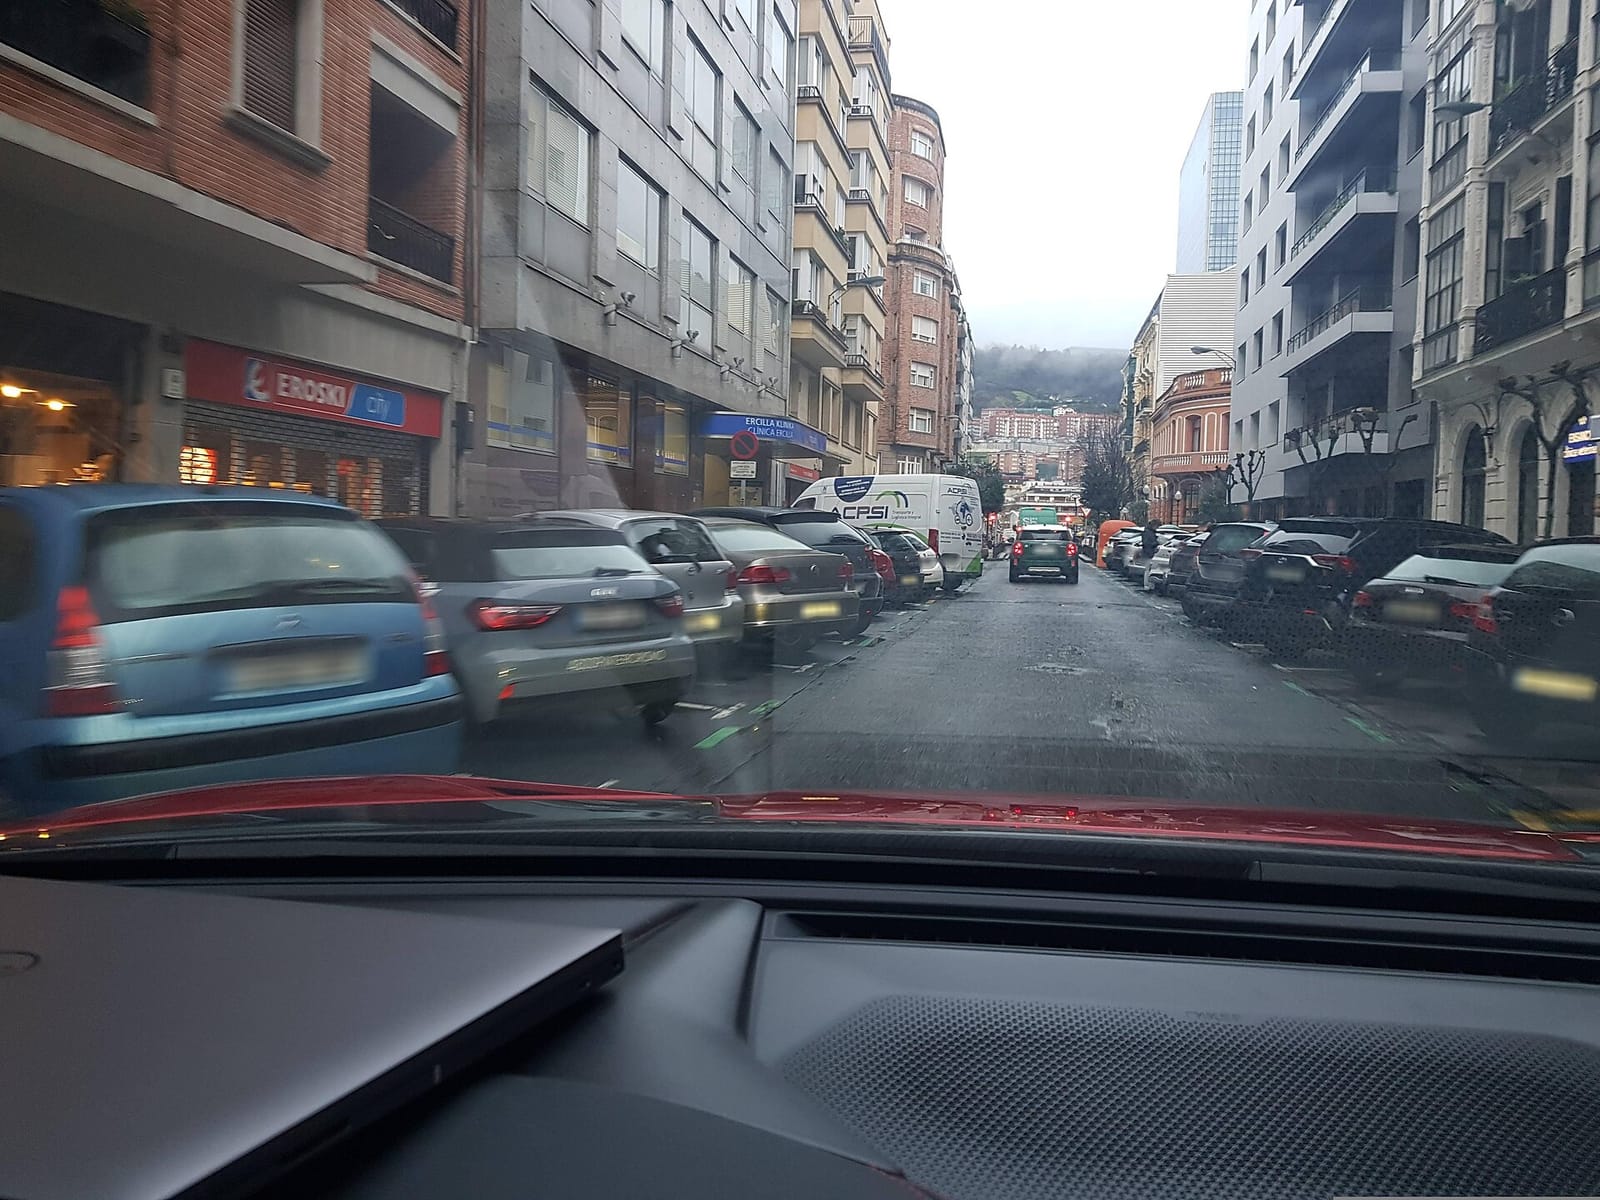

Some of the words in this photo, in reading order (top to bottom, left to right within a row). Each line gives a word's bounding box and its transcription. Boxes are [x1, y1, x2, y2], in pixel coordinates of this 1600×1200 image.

[276, 372, 347, 408] EROSKI
[366, 392, 391, 422] city
[745, 417, 775, 428] ERCILLA
[832, 506, 889, 520] ACPSI
